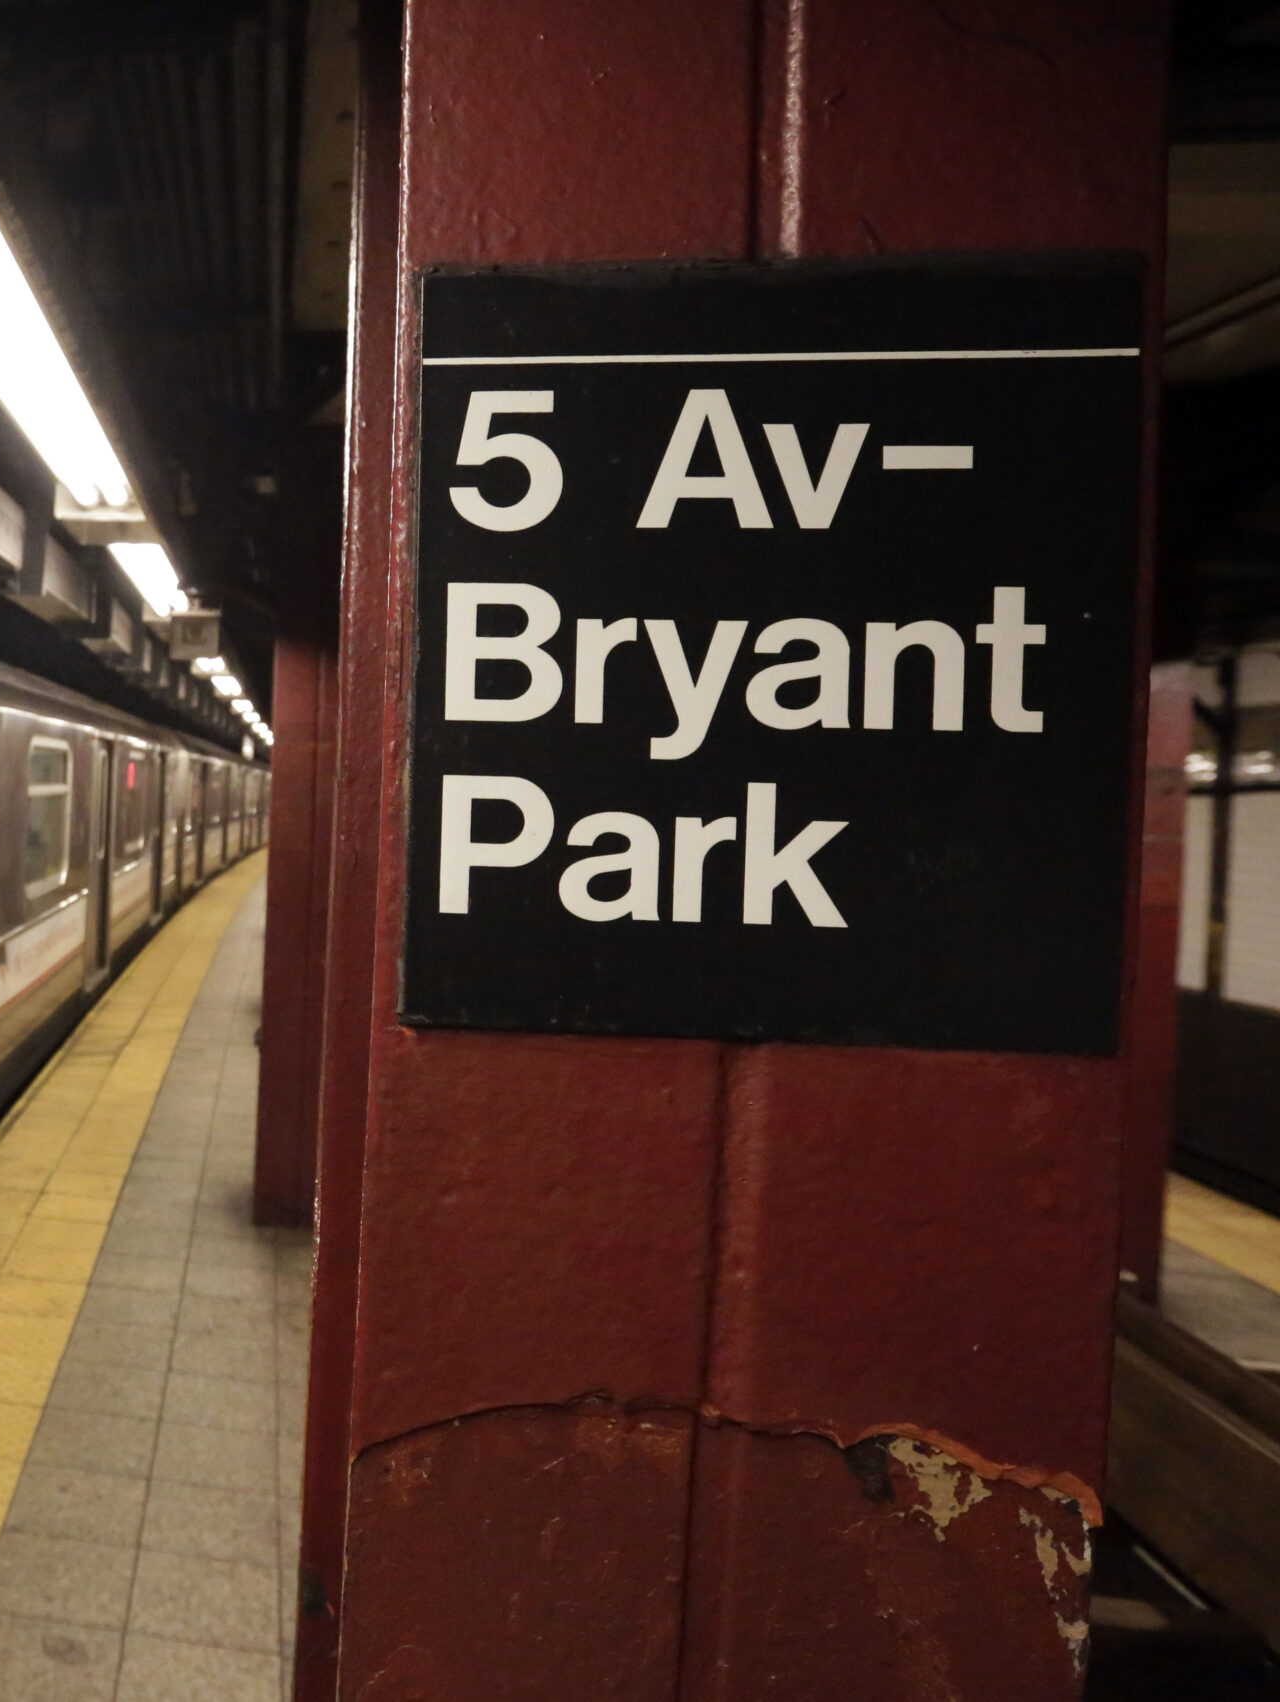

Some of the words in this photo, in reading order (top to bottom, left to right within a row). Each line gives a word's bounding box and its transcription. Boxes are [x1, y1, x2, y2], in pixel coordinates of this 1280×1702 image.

[447, 389, 565, 533] 5
[443, 581, 1048, 761] Bryant
[437, 773, 850, 929] Park
